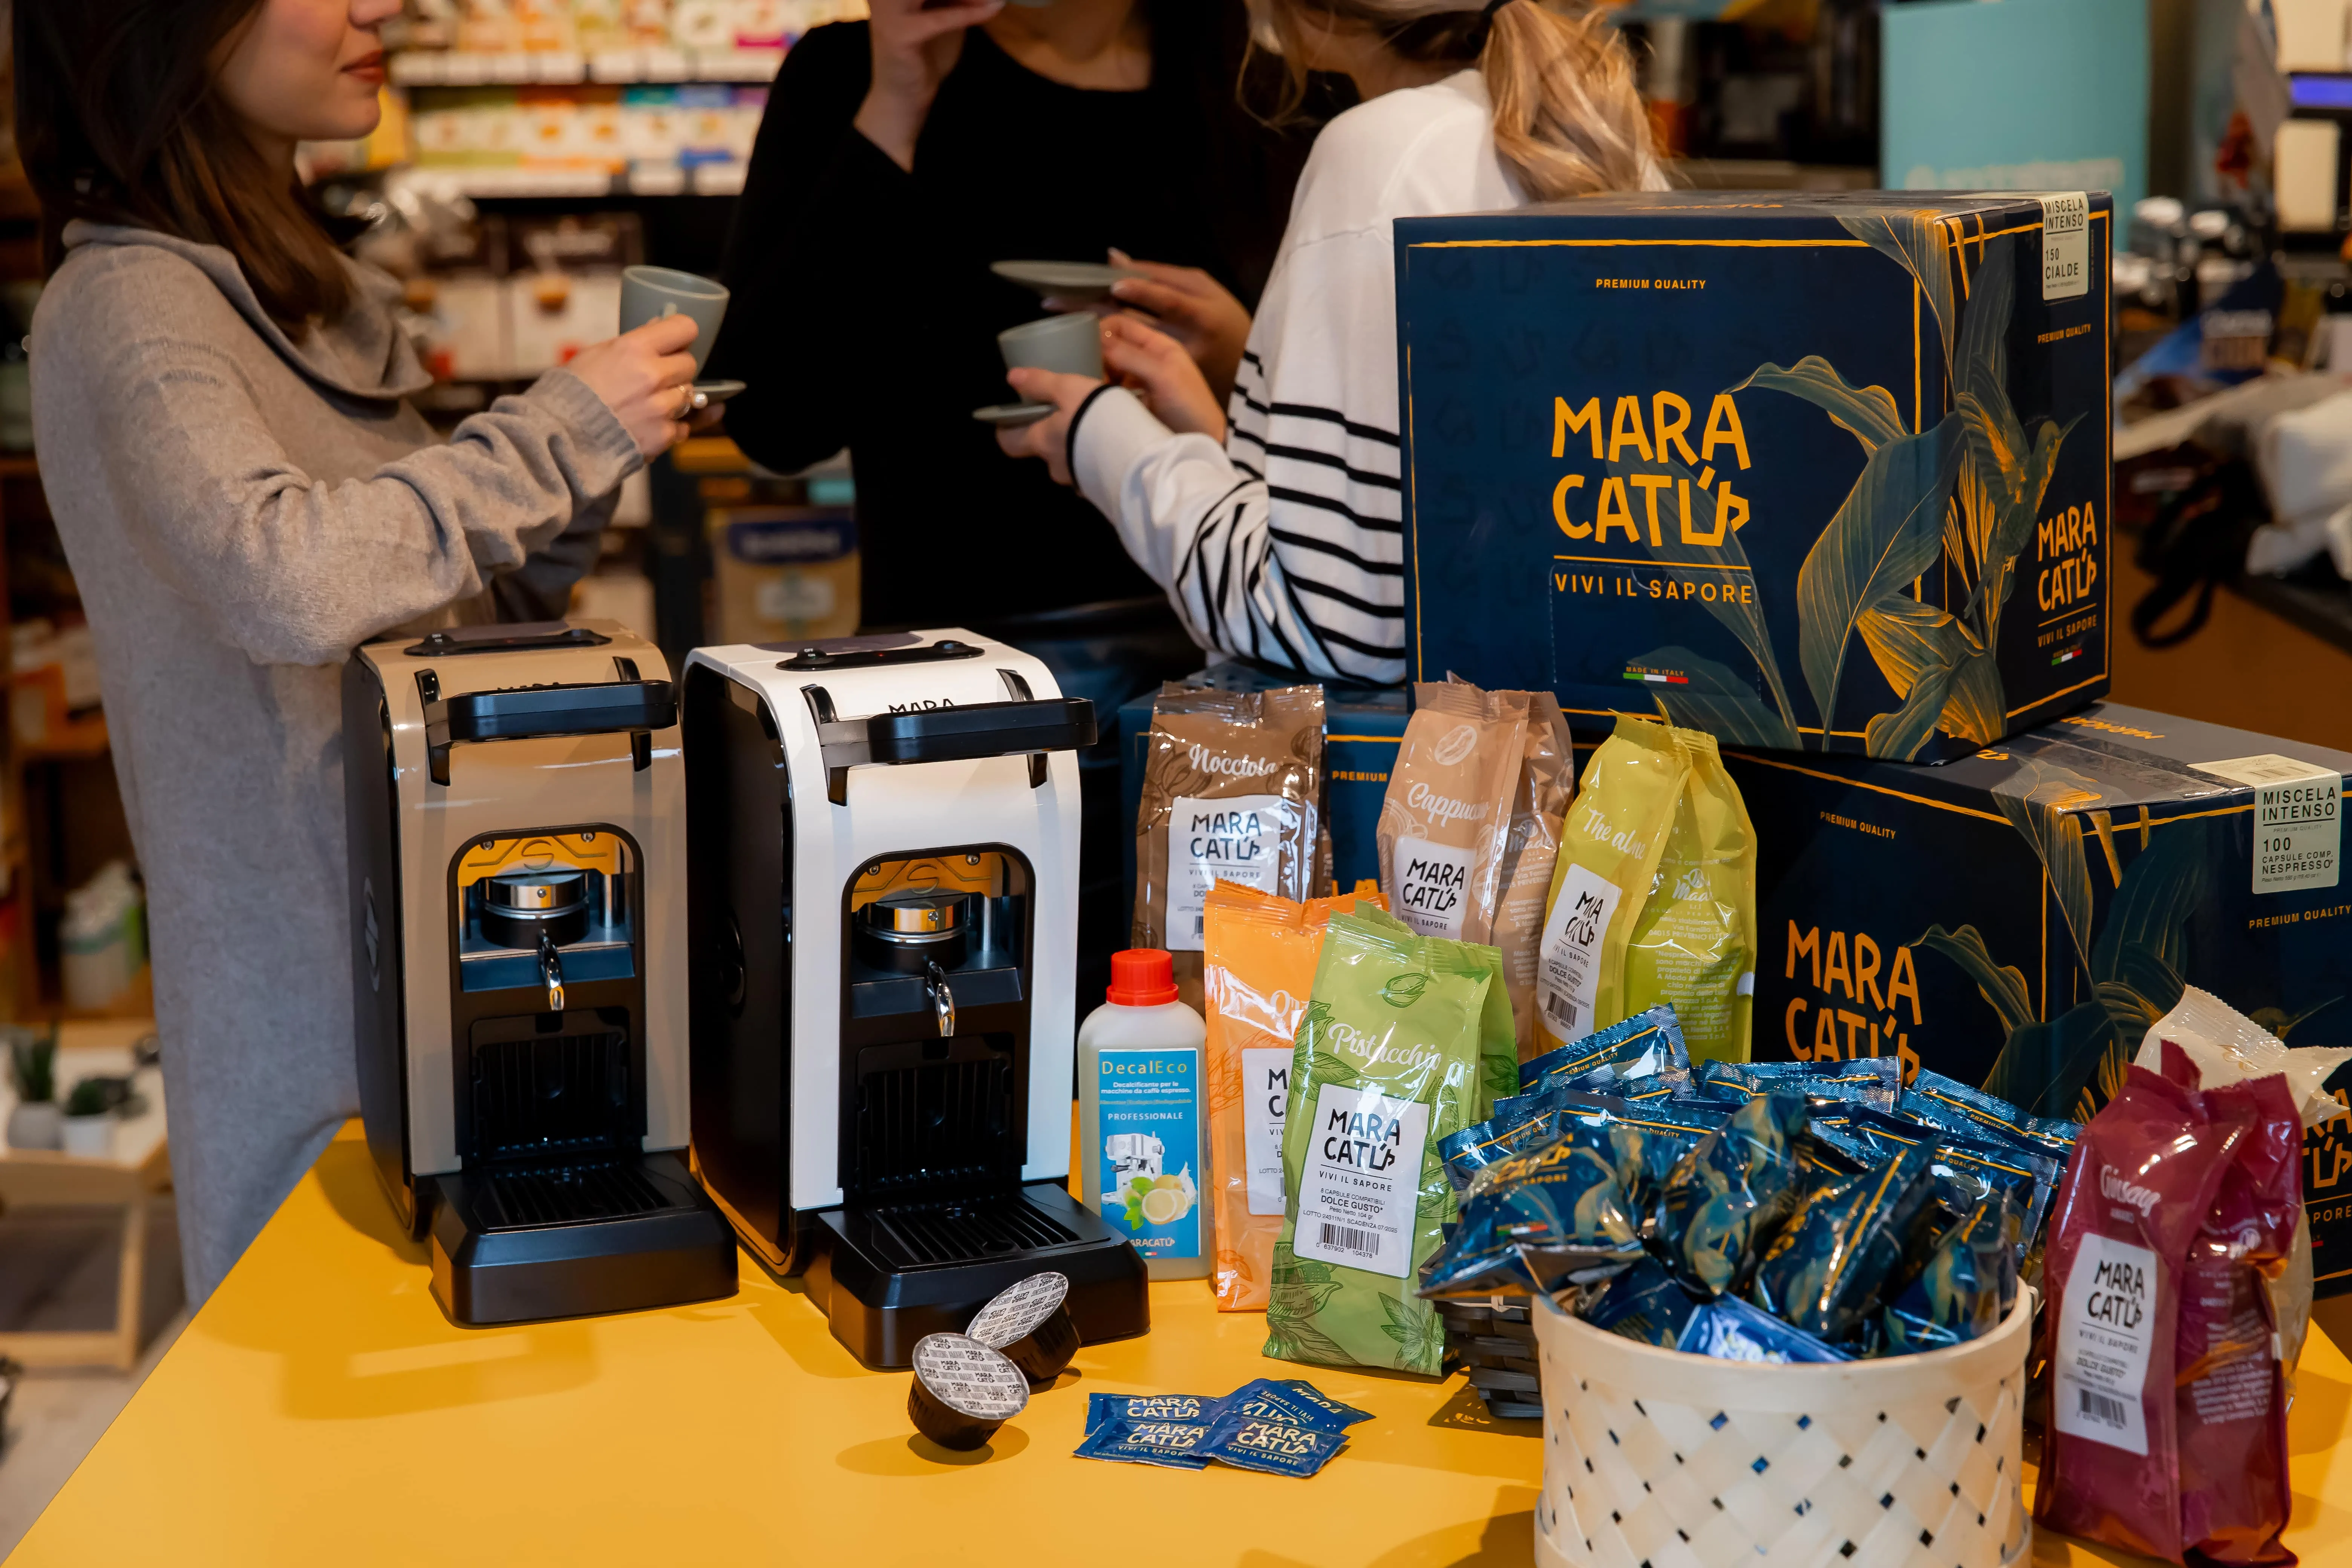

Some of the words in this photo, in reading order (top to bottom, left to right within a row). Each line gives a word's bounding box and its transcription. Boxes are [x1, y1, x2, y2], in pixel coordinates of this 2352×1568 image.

[2044, 198, 2084, 214] MISCELA
[2045, 213, 2084, 230] INTENSO
[2046, 247, 2060, 261] 150
[2045, 263, 2079, 280] CIALDE
[1596, 279, 1649, 289] PREMIUM
[1655, 279, 1706, 289] QUALITY
[2038, 329, 2064, 345] PREMIUM
[2066, 324, 2092, 335] QUALITY
[1551, 390, 1752, 470] MARA
[2038, 501, 2098, 562] MARA
[1554, 573, 1604, 594] VIVI
[1616, 577, 1637, 597] IL
[1649, 579, 1753, 603] SAPORE
[2038, 635, 2054, 648] VIVI
[2056, 628, 2064, 640] IL
[2066, 614, 2098, 637] SAPORE
[1188, 744, 1279, 777] Nocciola
[1332, 770, 1388, 782] PREMIUM
[2263, 786, 2336, 805] MISCELA
[2263, 802, 2335, 821] INTENSO
[1191, 811, 1262, 836] MARA
[1820, 811, 1857, 829] PREMIUM
[1860, 821, 1896, 840] QUALITY
[2263, 837, 2291, 853] 100
[2262, 853, 2303, 864] CAPSULE
[2306, 850, 2334, 859] COMP.
[1223, 870, 1260, 878] SAPORE
[1406, 858, 1465, 891] MARA
[1421, 919, 1448, 931] SAPORE
[2249, 913, 2300, 929] PREMIUM
[2304, 905, 2352, 921] QUALITY
[1569, 952, 1589, 968] SAPORE
[1549, 965, 1567, 979] DOLCE
[1785, 919, 1923, 1026] MARA
[1328, 1023, 1442, 1071] Pistacchio
[1102, 1060, 1187, 1075] DecalEco
[1591, 1052, 1619, 1067] QUALITY
[1108, 1112, 1183, 1121] PROFESSIONALE
[1328, 1108, 1400, 1146] MARA
[1649, 1128, 1680, 1138] QUALITY
[1319, 1170, 1337, 1181] VIVI
[1353, 1178, 1392, 1192] SAPORE
[1321, 1195, 1349, 1207] DOLCE
[1325, 1188, 1351, 1199] CAPSULE
[1351, 1194, 1386, 1205] COMPATIBILI
[1303, 1209, 1321, 1218] LOTTO
[1322, 1214, 1345, 1223] 24311N/1
[1347, 1218, 1377, 1230] SCADENZA
[1323, 1244, 1345, 1253] 637902
[1352, 1250, 1373, 1259] 104378
[2093, 1259, 2145, 1300] MARA
[1127, 1398, 1201, 1407] MARA
[1260, 1390, 1290, 1406] SAPORE
[1298, 1409, 1315, 1422] VIVI
[1133, 1423, 1205, 1439] MARA
[1245, 1422, 1317, 1446] MARA
[1152, 1448, 1183, 1456] SAPOR
[1227, 1446, 1245, 1455] VIVI
[1260, 1453, 1298, 1466] SAPORE
